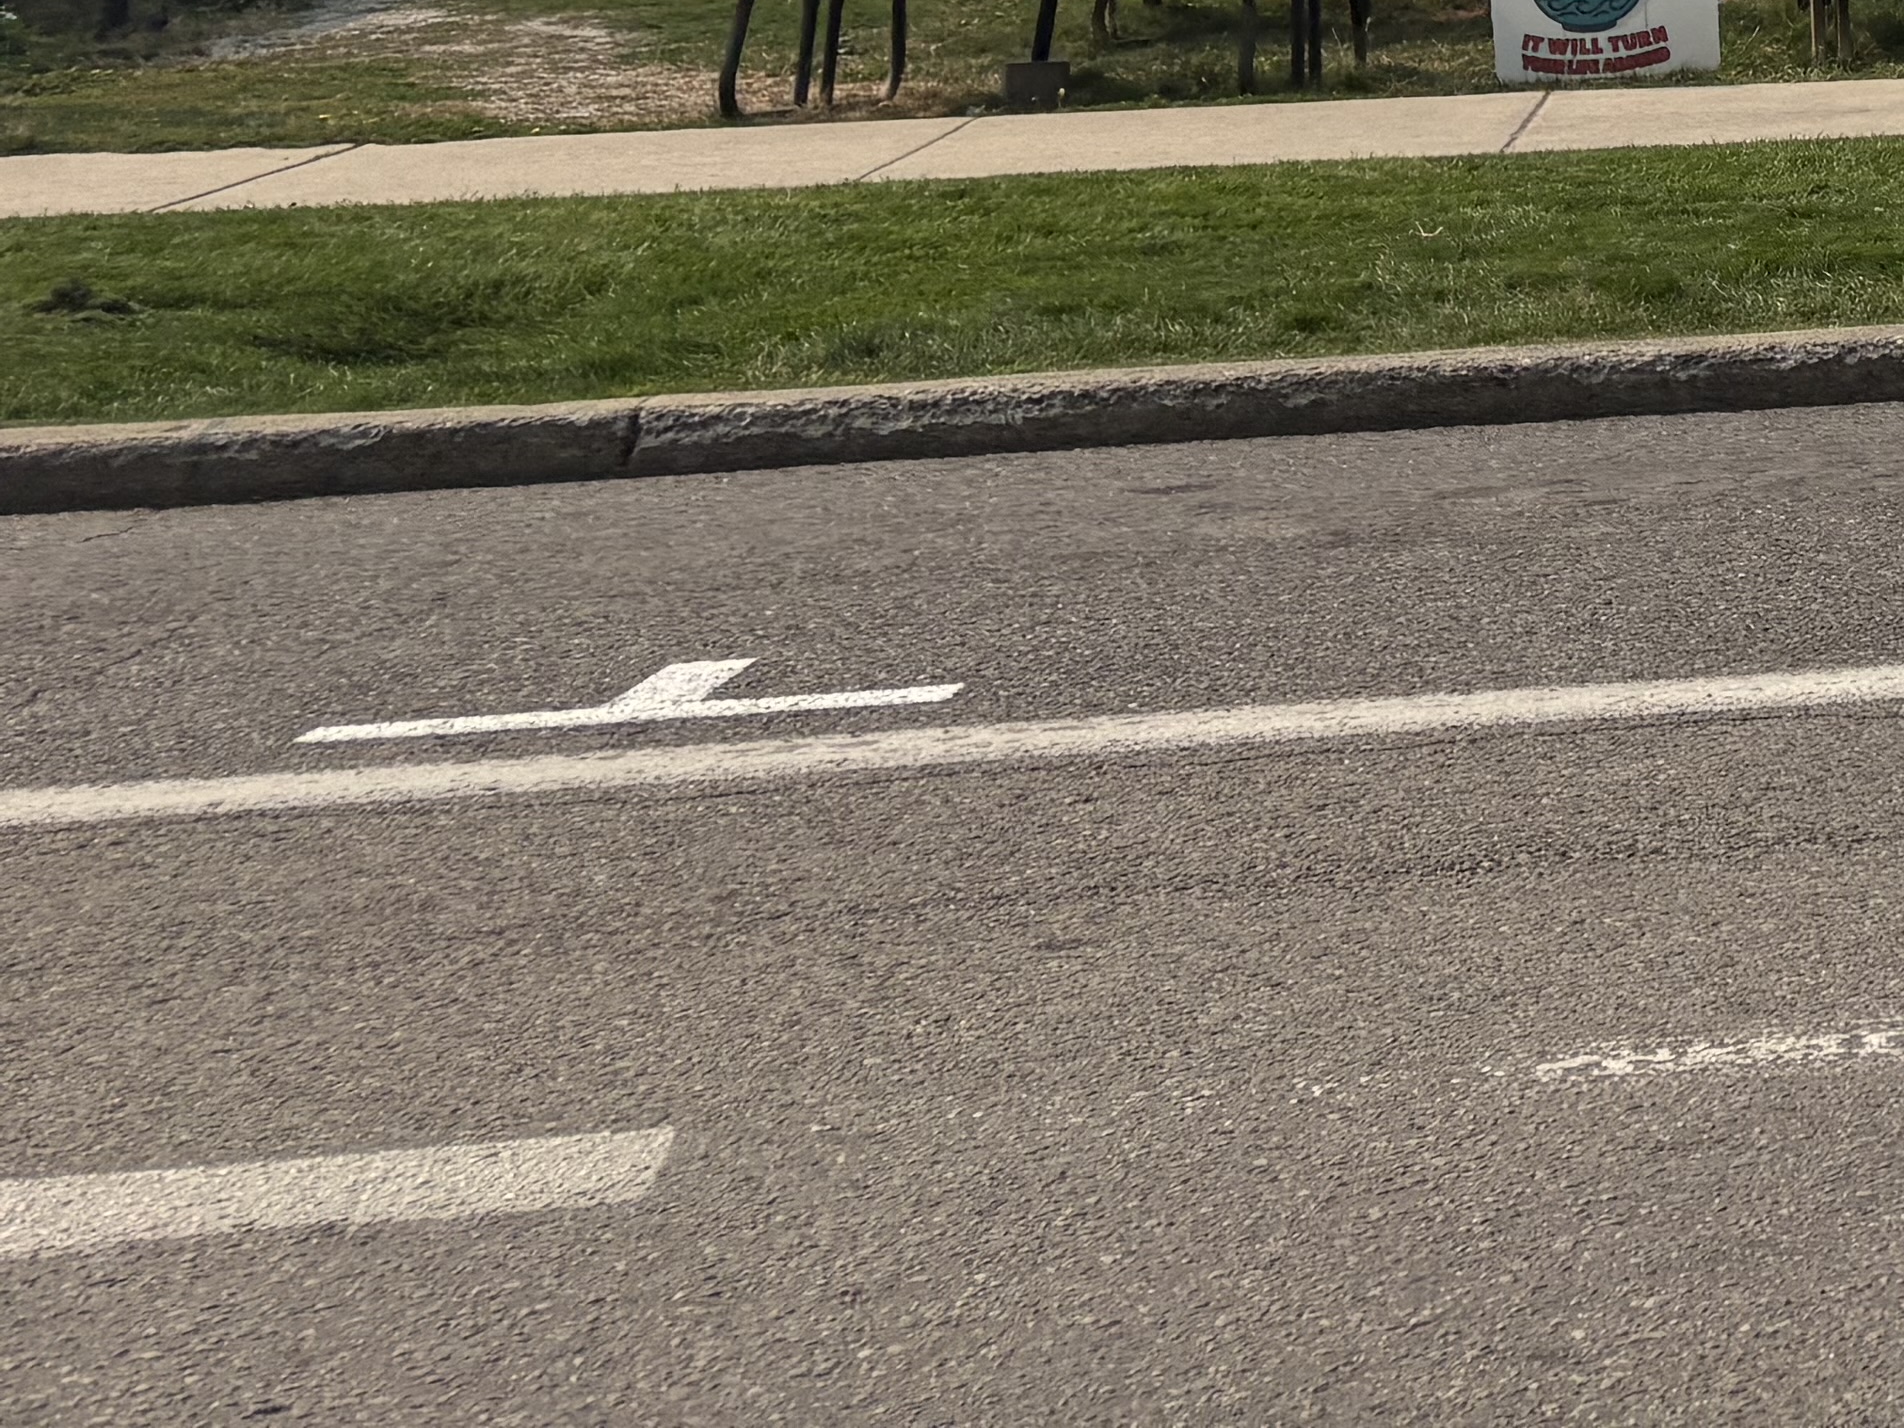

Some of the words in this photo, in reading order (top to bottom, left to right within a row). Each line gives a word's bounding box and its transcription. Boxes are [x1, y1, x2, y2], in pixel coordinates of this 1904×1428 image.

[1521, 33, 1545, 53] IT
[1547, 34, 1604, 56] WILL
[1607, 25, 1669, 53] TURN
